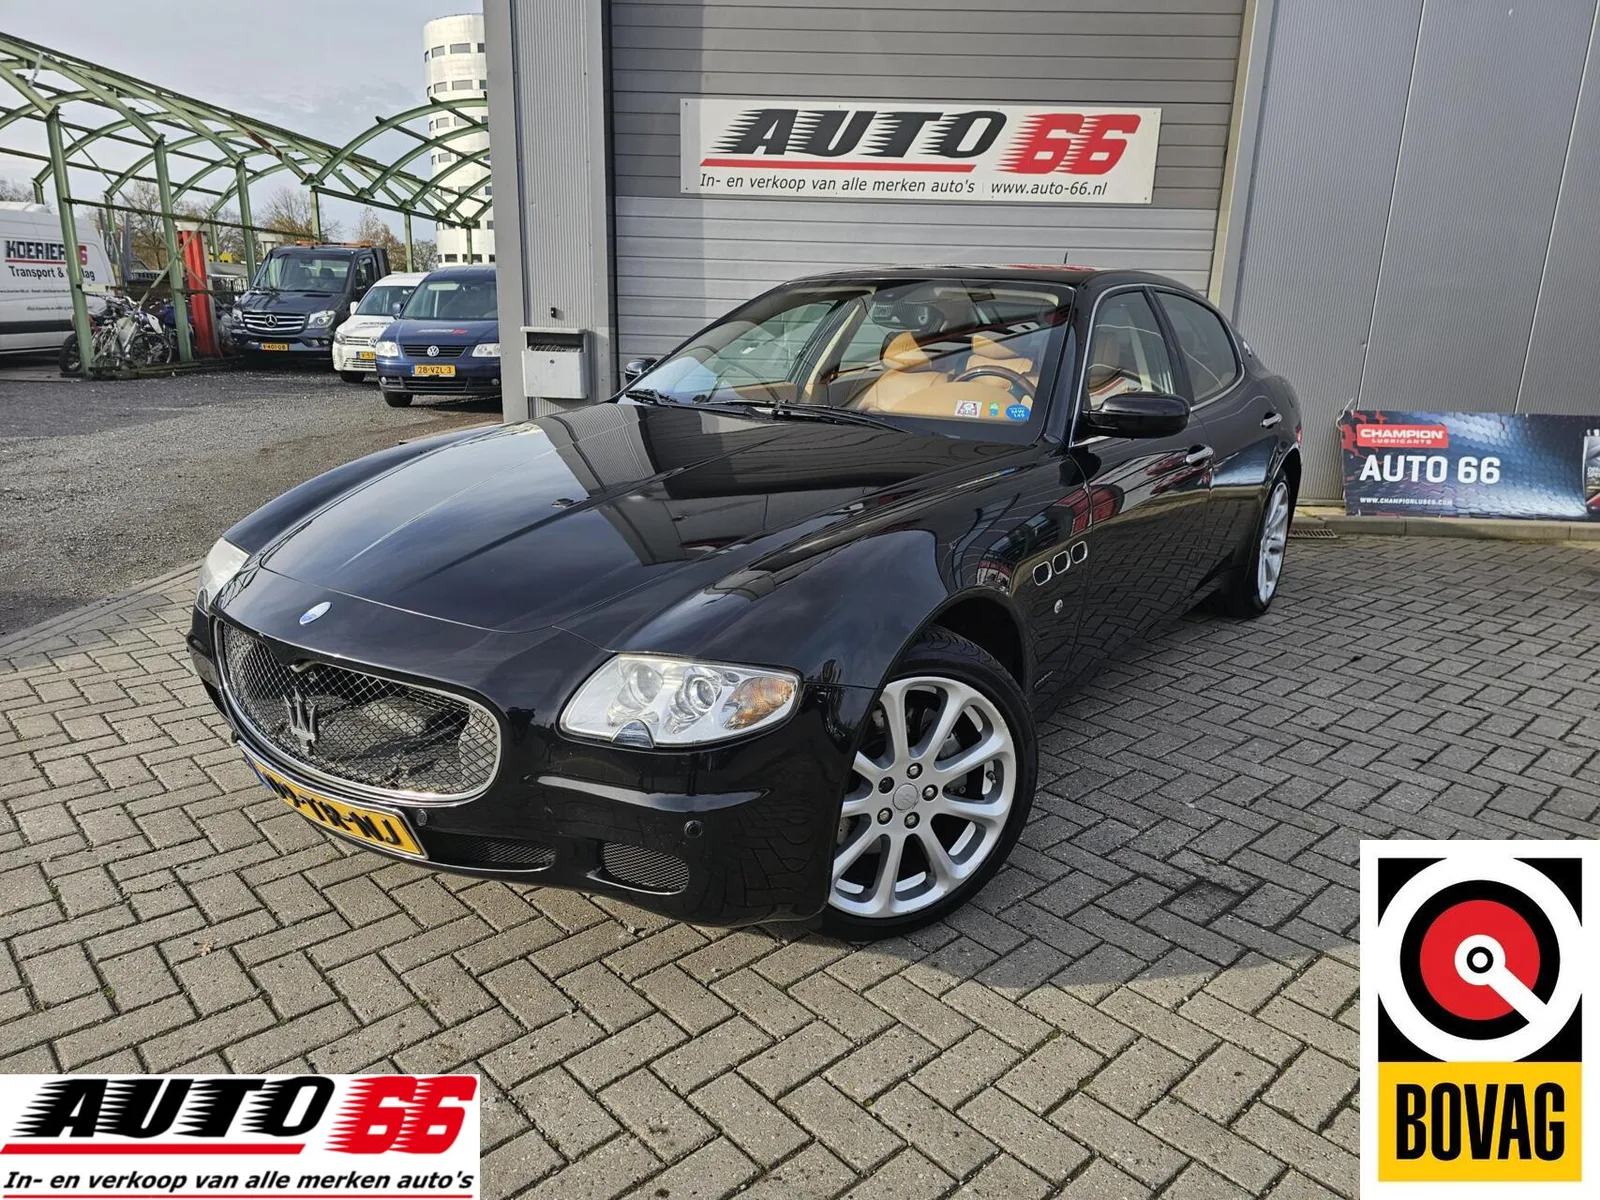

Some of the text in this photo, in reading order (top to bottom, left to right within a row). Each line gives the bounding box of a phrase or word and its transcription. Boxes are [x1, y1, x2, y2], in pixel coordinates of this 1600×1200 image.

[705, 109, 1141, 176] AUTO 66
[700, 173, 975, 194] In- en verkoop van alle merken auto's
[990, 181, 1108, 196] www.auto-66.nl
[8, 265, 56, 280] Transport
[57, 267, 65, 278] &
[1360, 428, 1443, 440] CHAMPION
[1359, 454, 1501, 484] AUTO 66
